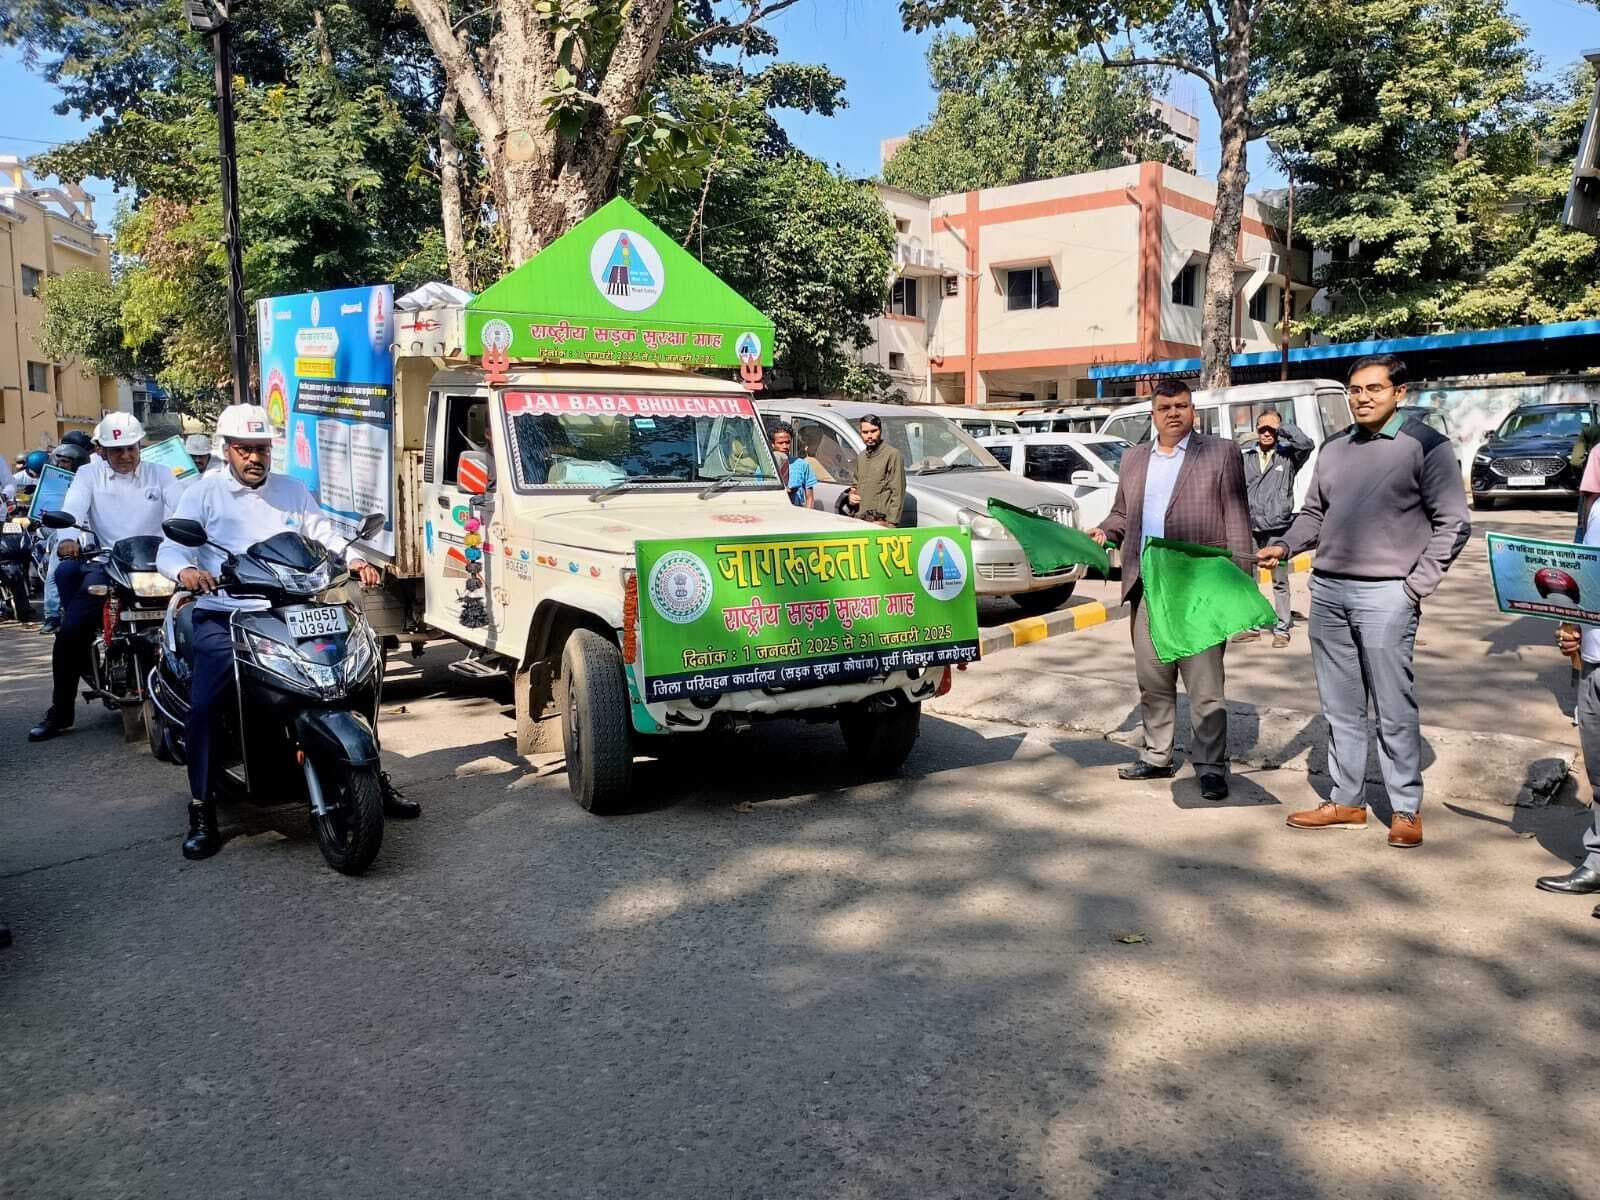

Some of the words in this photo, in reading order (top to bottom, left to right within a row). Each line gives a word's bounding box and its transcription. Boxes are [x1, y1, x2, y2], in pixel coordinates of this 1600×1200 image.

[529, 320, 588, 344] राष्ट्रीय
[593, 327, 637, 347] सड़क
[642, 330, 688, 349] सुरक्षा
[693, 332, 723, 348] माह
[522, 395, 560, 410] JAI
[568, 396, 632, 411] BABA
[637, 397, 741, 413] BHOLENATH
[112, 429, 122, 441] P
[716, 537, 871, 588] जागरूकता
[876, 535, 913, 578] रथ
[723, 596, 780, 636] राष्ट्रीय
[785, 600, 829, 630] सड़क
[834, 595, 880, 629] सुरक्षा
[885, 593, 915, 616] माह
[683, 645, 727, 667] दिनांक
[743, 645, 750, 660] 1
[756, 638, 801, 659] जनवरी
[807, 637, 838, 653] 2025
[843, 634, 855, 649] से
[860, 633, 874, 647] 31
[879, 626, 919, 645] जनवरी
[924, 625, 952, 641] 2025
[653, 679, 682, 696] जिला
[686, 675, 729, 691] परिवहन
[732, 667, 776, 685] कार्यालय
[780, 665, 810, 681] (सड़क
[813, 662, 840, 679] सुरक्षा
[881, 651, 900, 671] पूर्वी
[902, 649, 934, 667] सिंहभूम
[937, 645, 977, 661] जमशेदपुर
